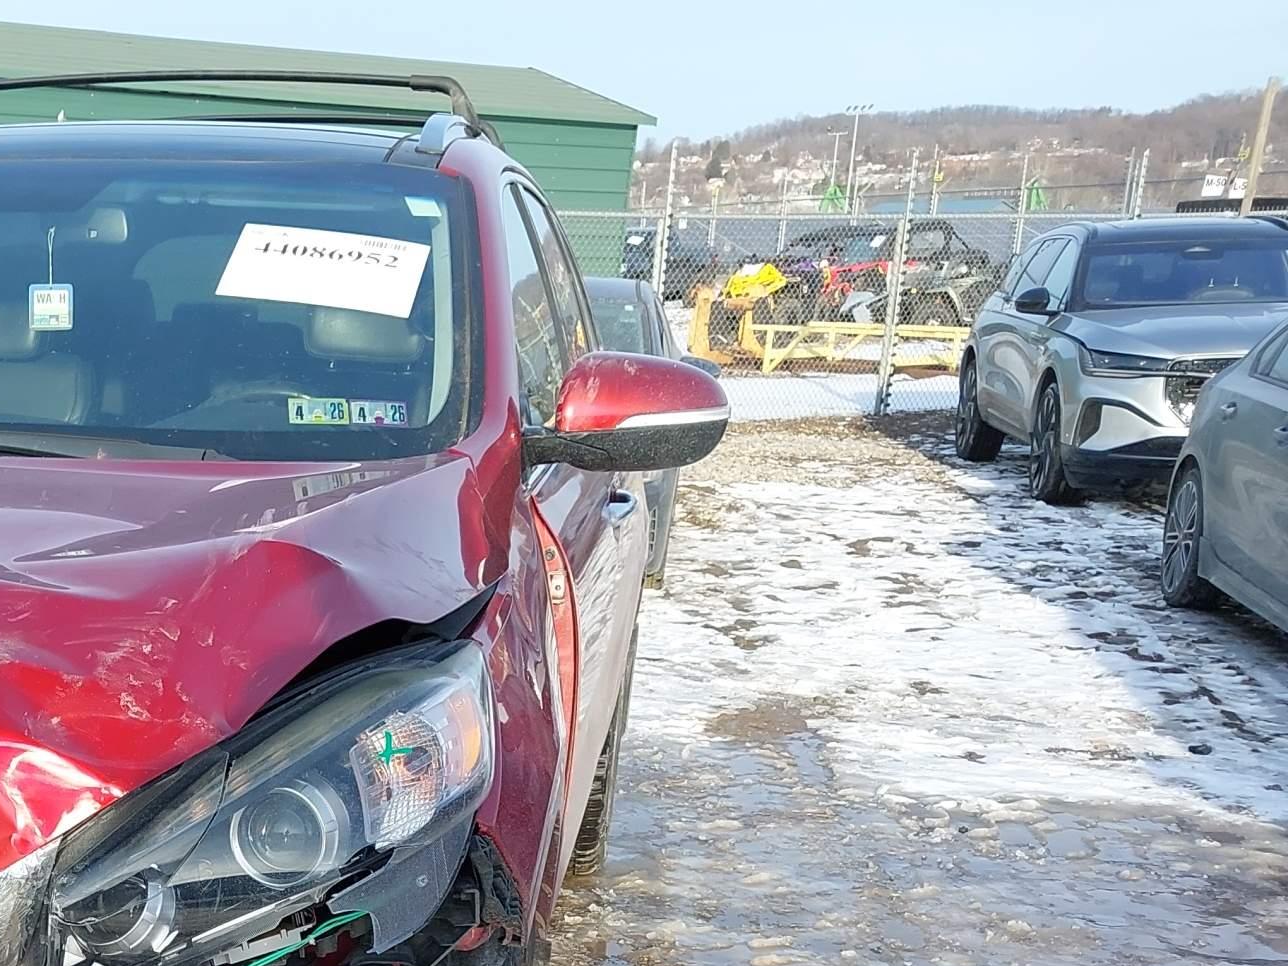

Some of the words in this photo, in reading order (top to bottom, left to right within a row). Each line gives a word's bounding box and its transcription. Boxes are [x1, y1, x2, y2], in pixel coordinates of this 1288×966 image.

[254, 241, 399, 268] 44086952
[295, 405, 305, 421] 4
[329, 402, 345, 421] 26
[357, 406, 367, 422] 4
[390, 404, 405, 422] 26
